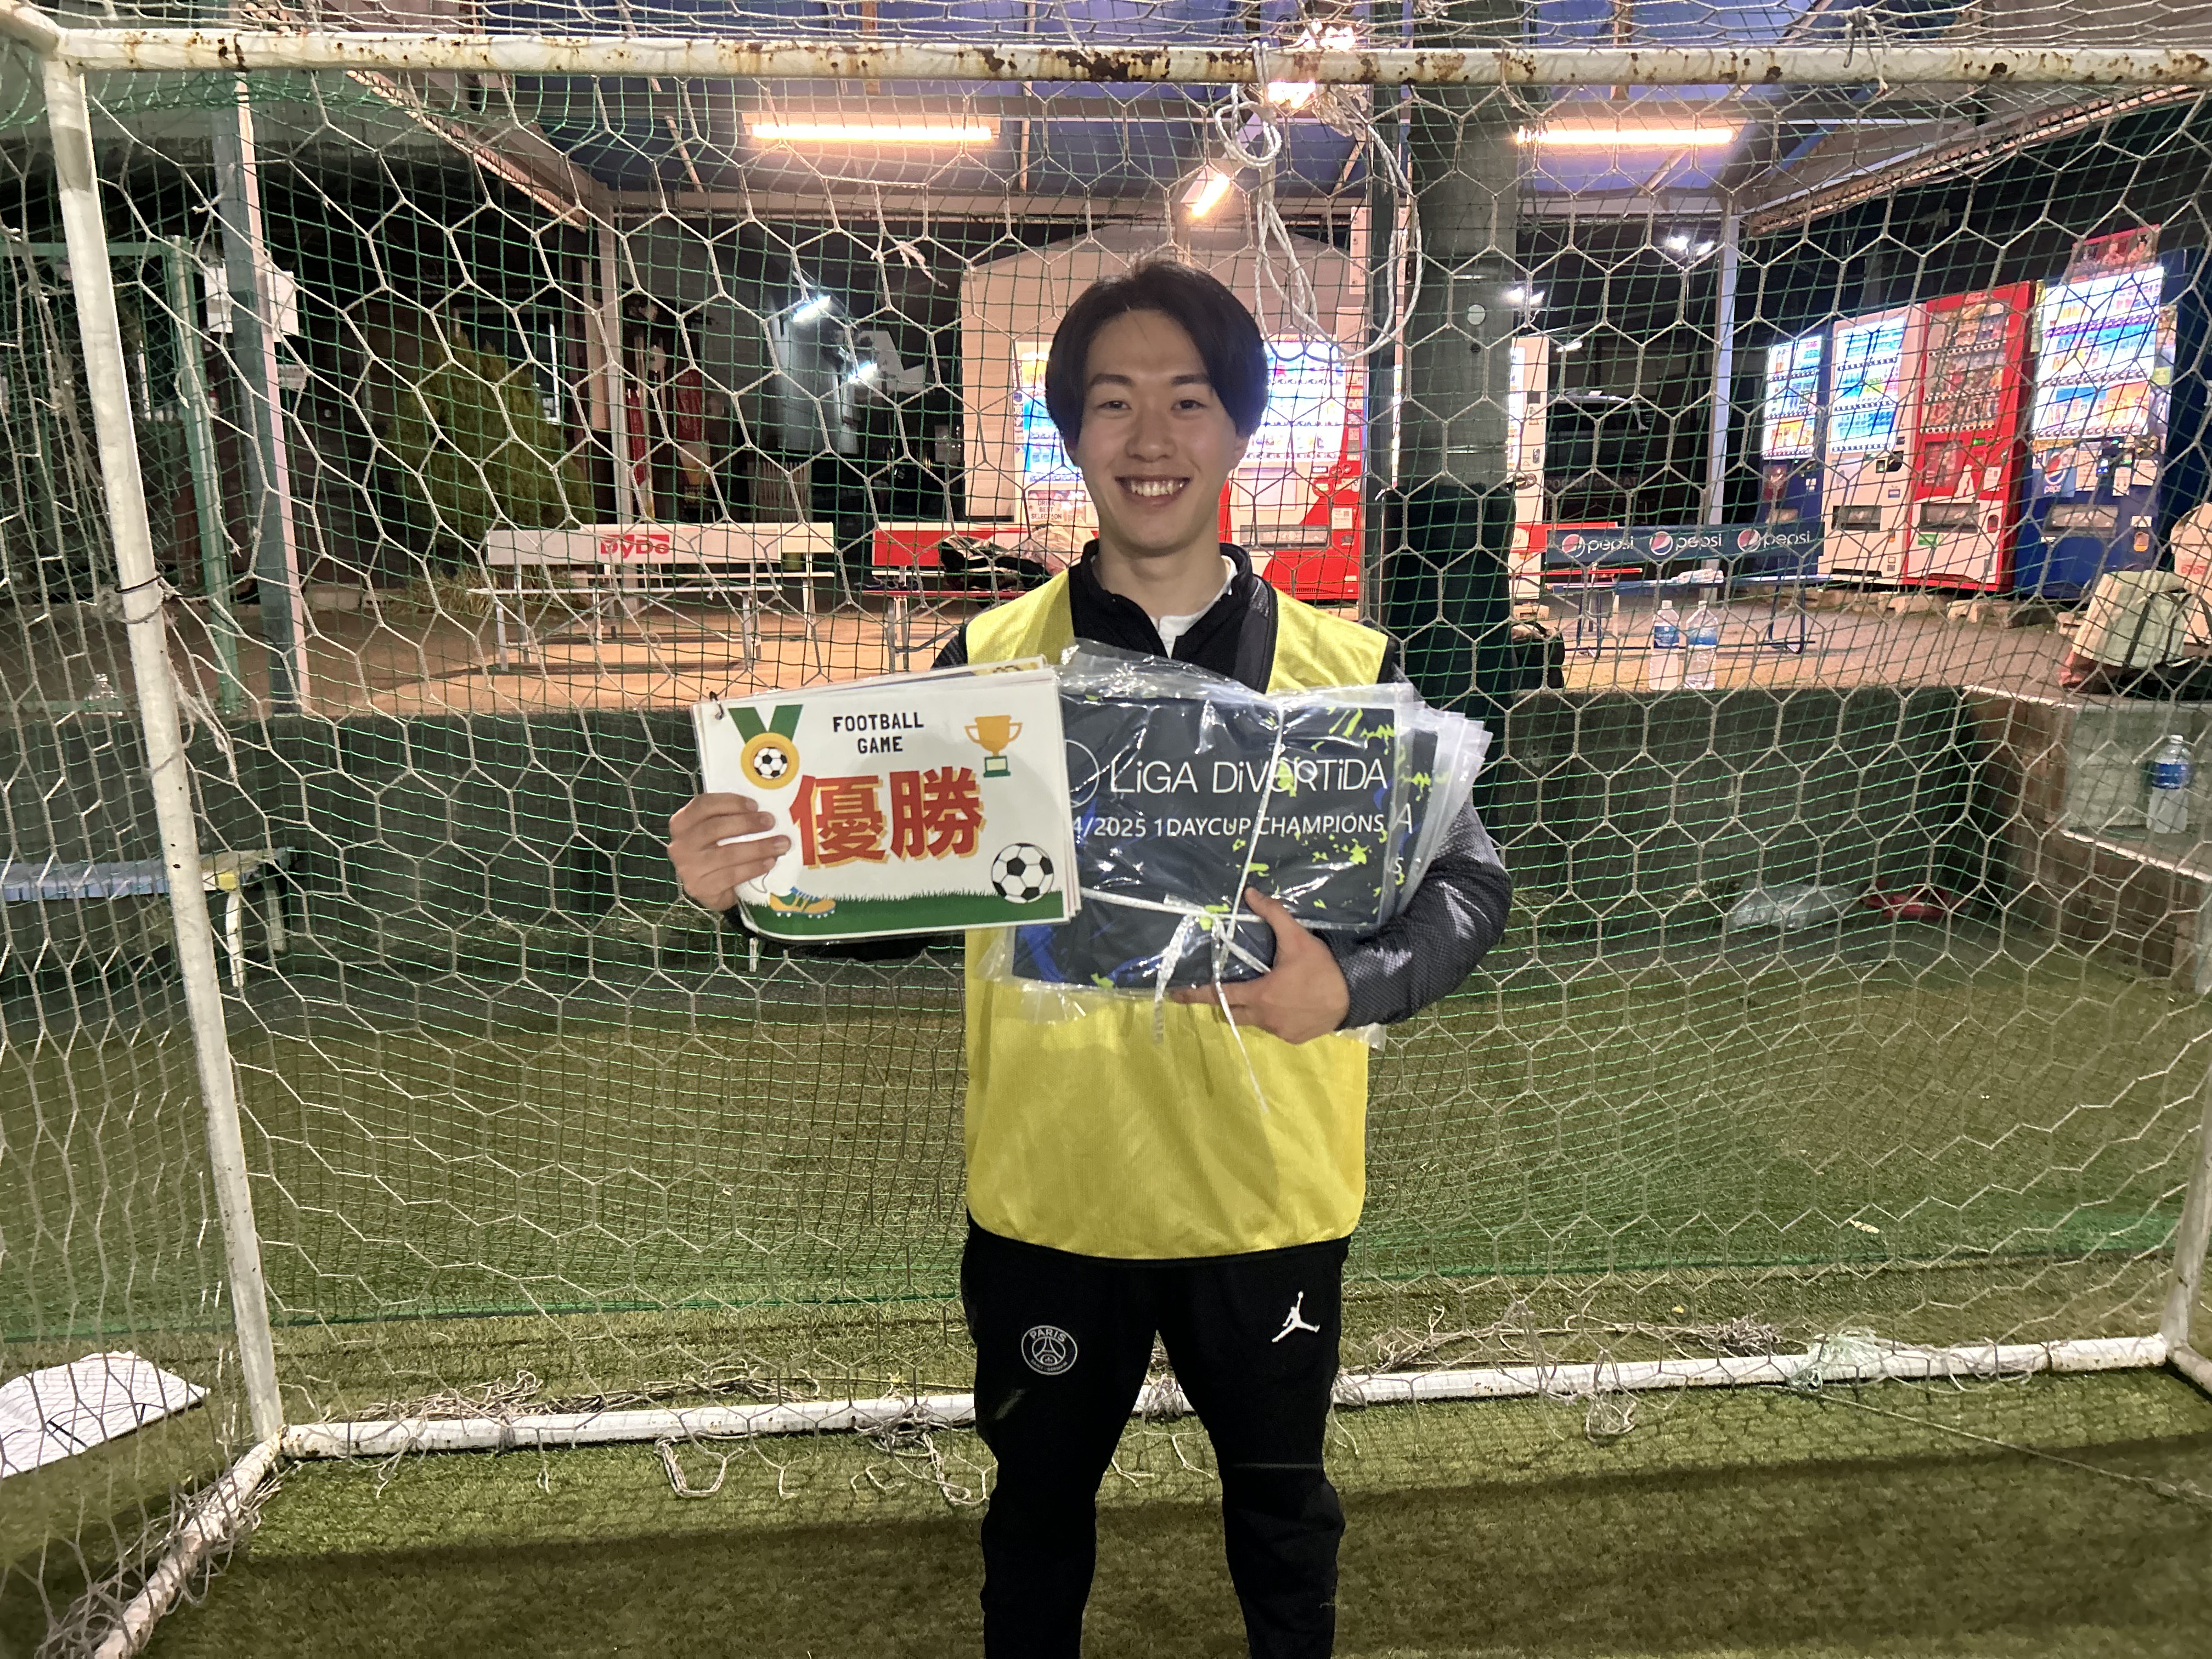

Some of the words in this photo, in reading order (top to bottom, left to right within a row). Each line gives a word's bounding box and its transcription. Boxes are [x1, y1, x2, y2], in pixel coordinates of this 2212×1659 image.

[2044, 485, 2062, 494] peps
[601, 534, 670, 558] DyDo
[1588, 535, 1634, 554] pepsi
[1675, 533, 1722, 551] pepsi
[1764, 531, 1810, 548] pepsi
[833, 712, 924, 732] FOOTBALL
[857, 736, 903, 754] GAME
[789, 766, 985, 868] 優勝
[1154, 817, 1251, 837] 1DAYCUP
[1259, 815, 1385, 838] CHAMPIONS
[1029, 1328, 1066, 1342] PARIS
